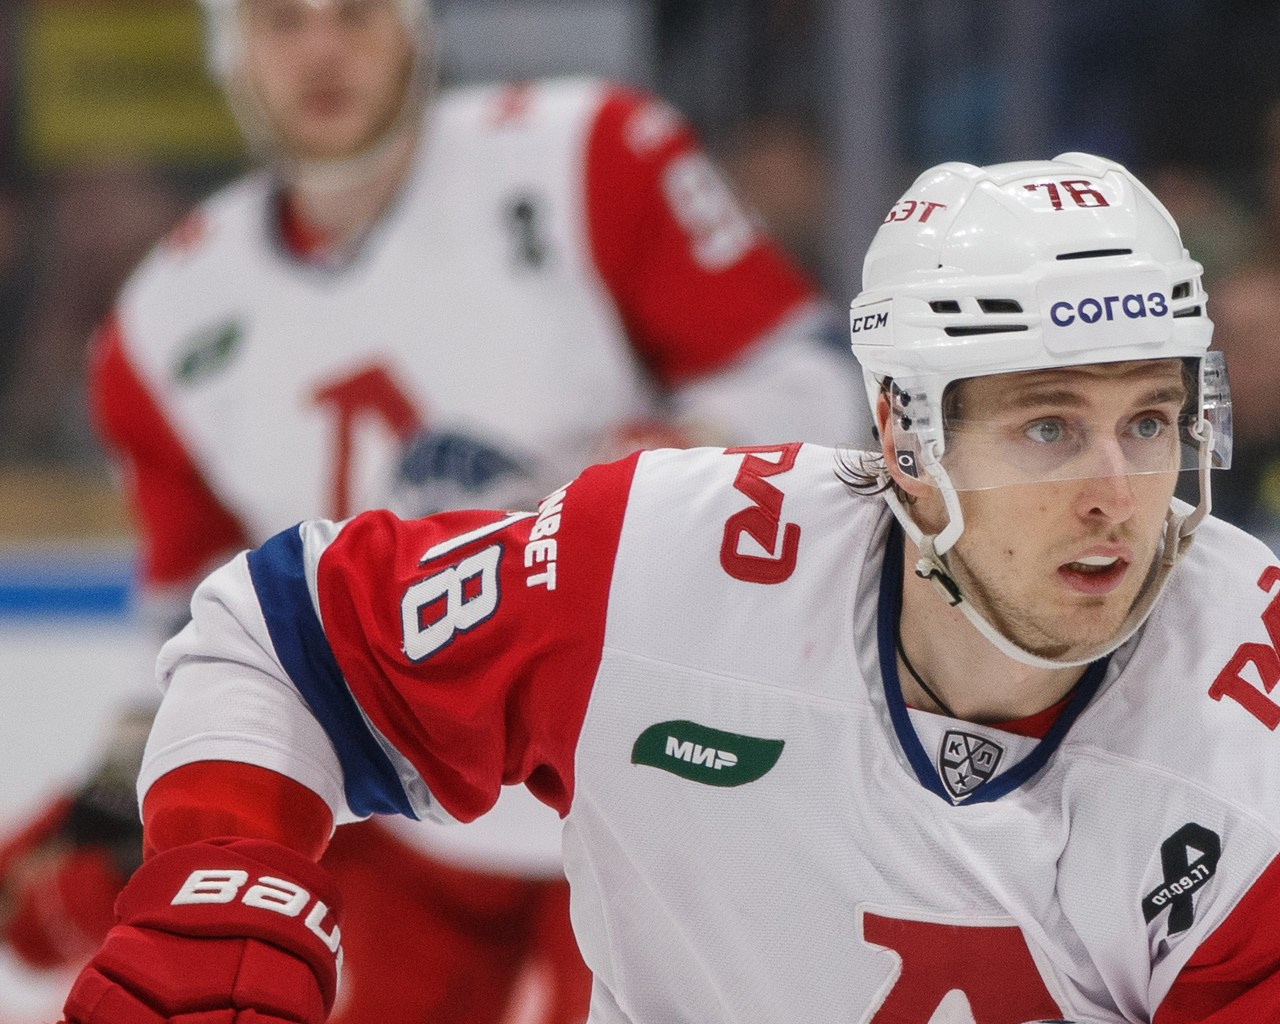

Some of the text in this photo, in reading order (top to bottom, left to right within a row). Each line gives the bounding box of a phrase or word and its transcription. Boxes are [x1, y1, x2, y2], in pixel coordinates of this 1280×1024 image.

[852, 312, 889, 333] CCM
[523, 481, 573, 591] NBET
[665, 736, 738, 770] МИР
[1152, 864, 1209, 905] 07.09.11
